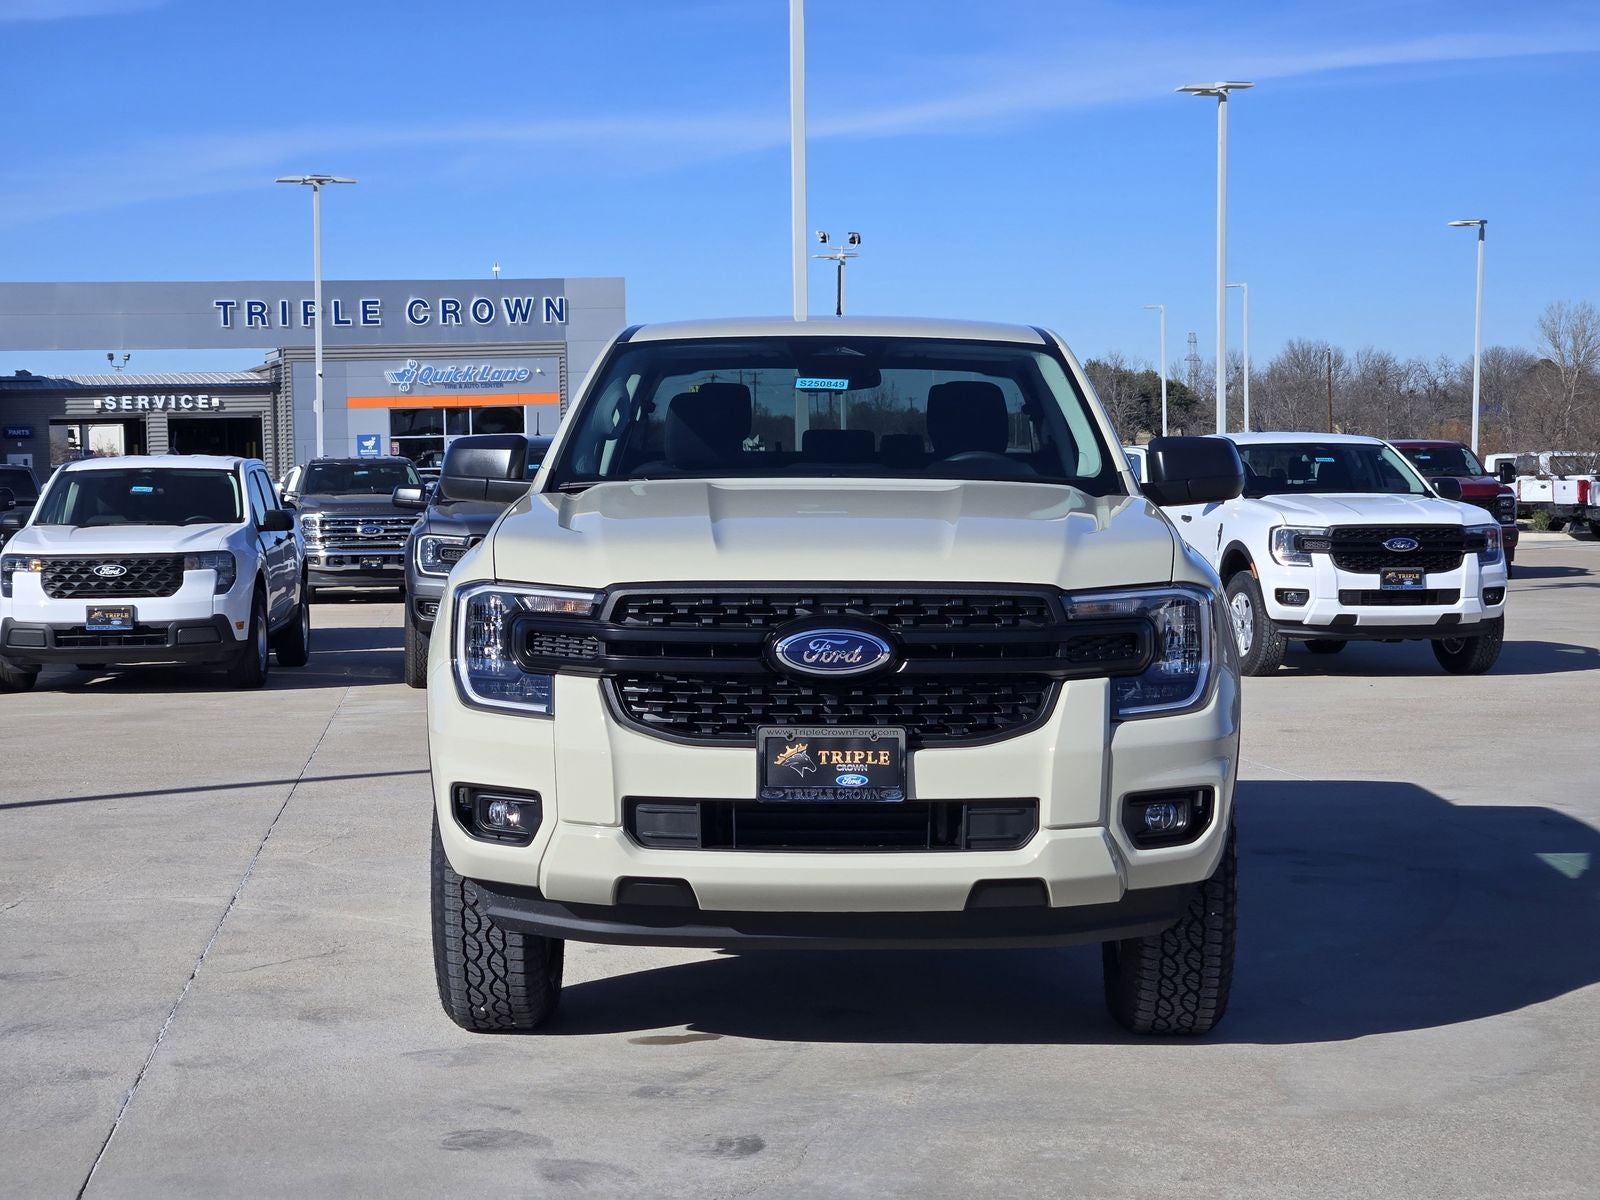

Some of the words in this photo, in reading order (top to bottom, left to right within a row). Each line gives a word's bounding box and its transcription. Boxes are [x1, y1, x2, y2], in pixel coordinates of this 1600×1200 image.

[213, 299, 382, 327] TRIPLE
[406, 297, 566, 325] CROWN
[417, 365, 477, 386] Quick
[477, 364, 530, 383] Lane
[799, 379, 845, 388] S250849
[104, 394, 209, 410] SERVICE
[802, 638, 864, 664] Ford
[818, 750, 890, 766] TRIPLE
[836, 764, 868, 772] CROWN
[784, 788, 834, 800] TRIPLE
[836, 788, 881, 800] CROWN
